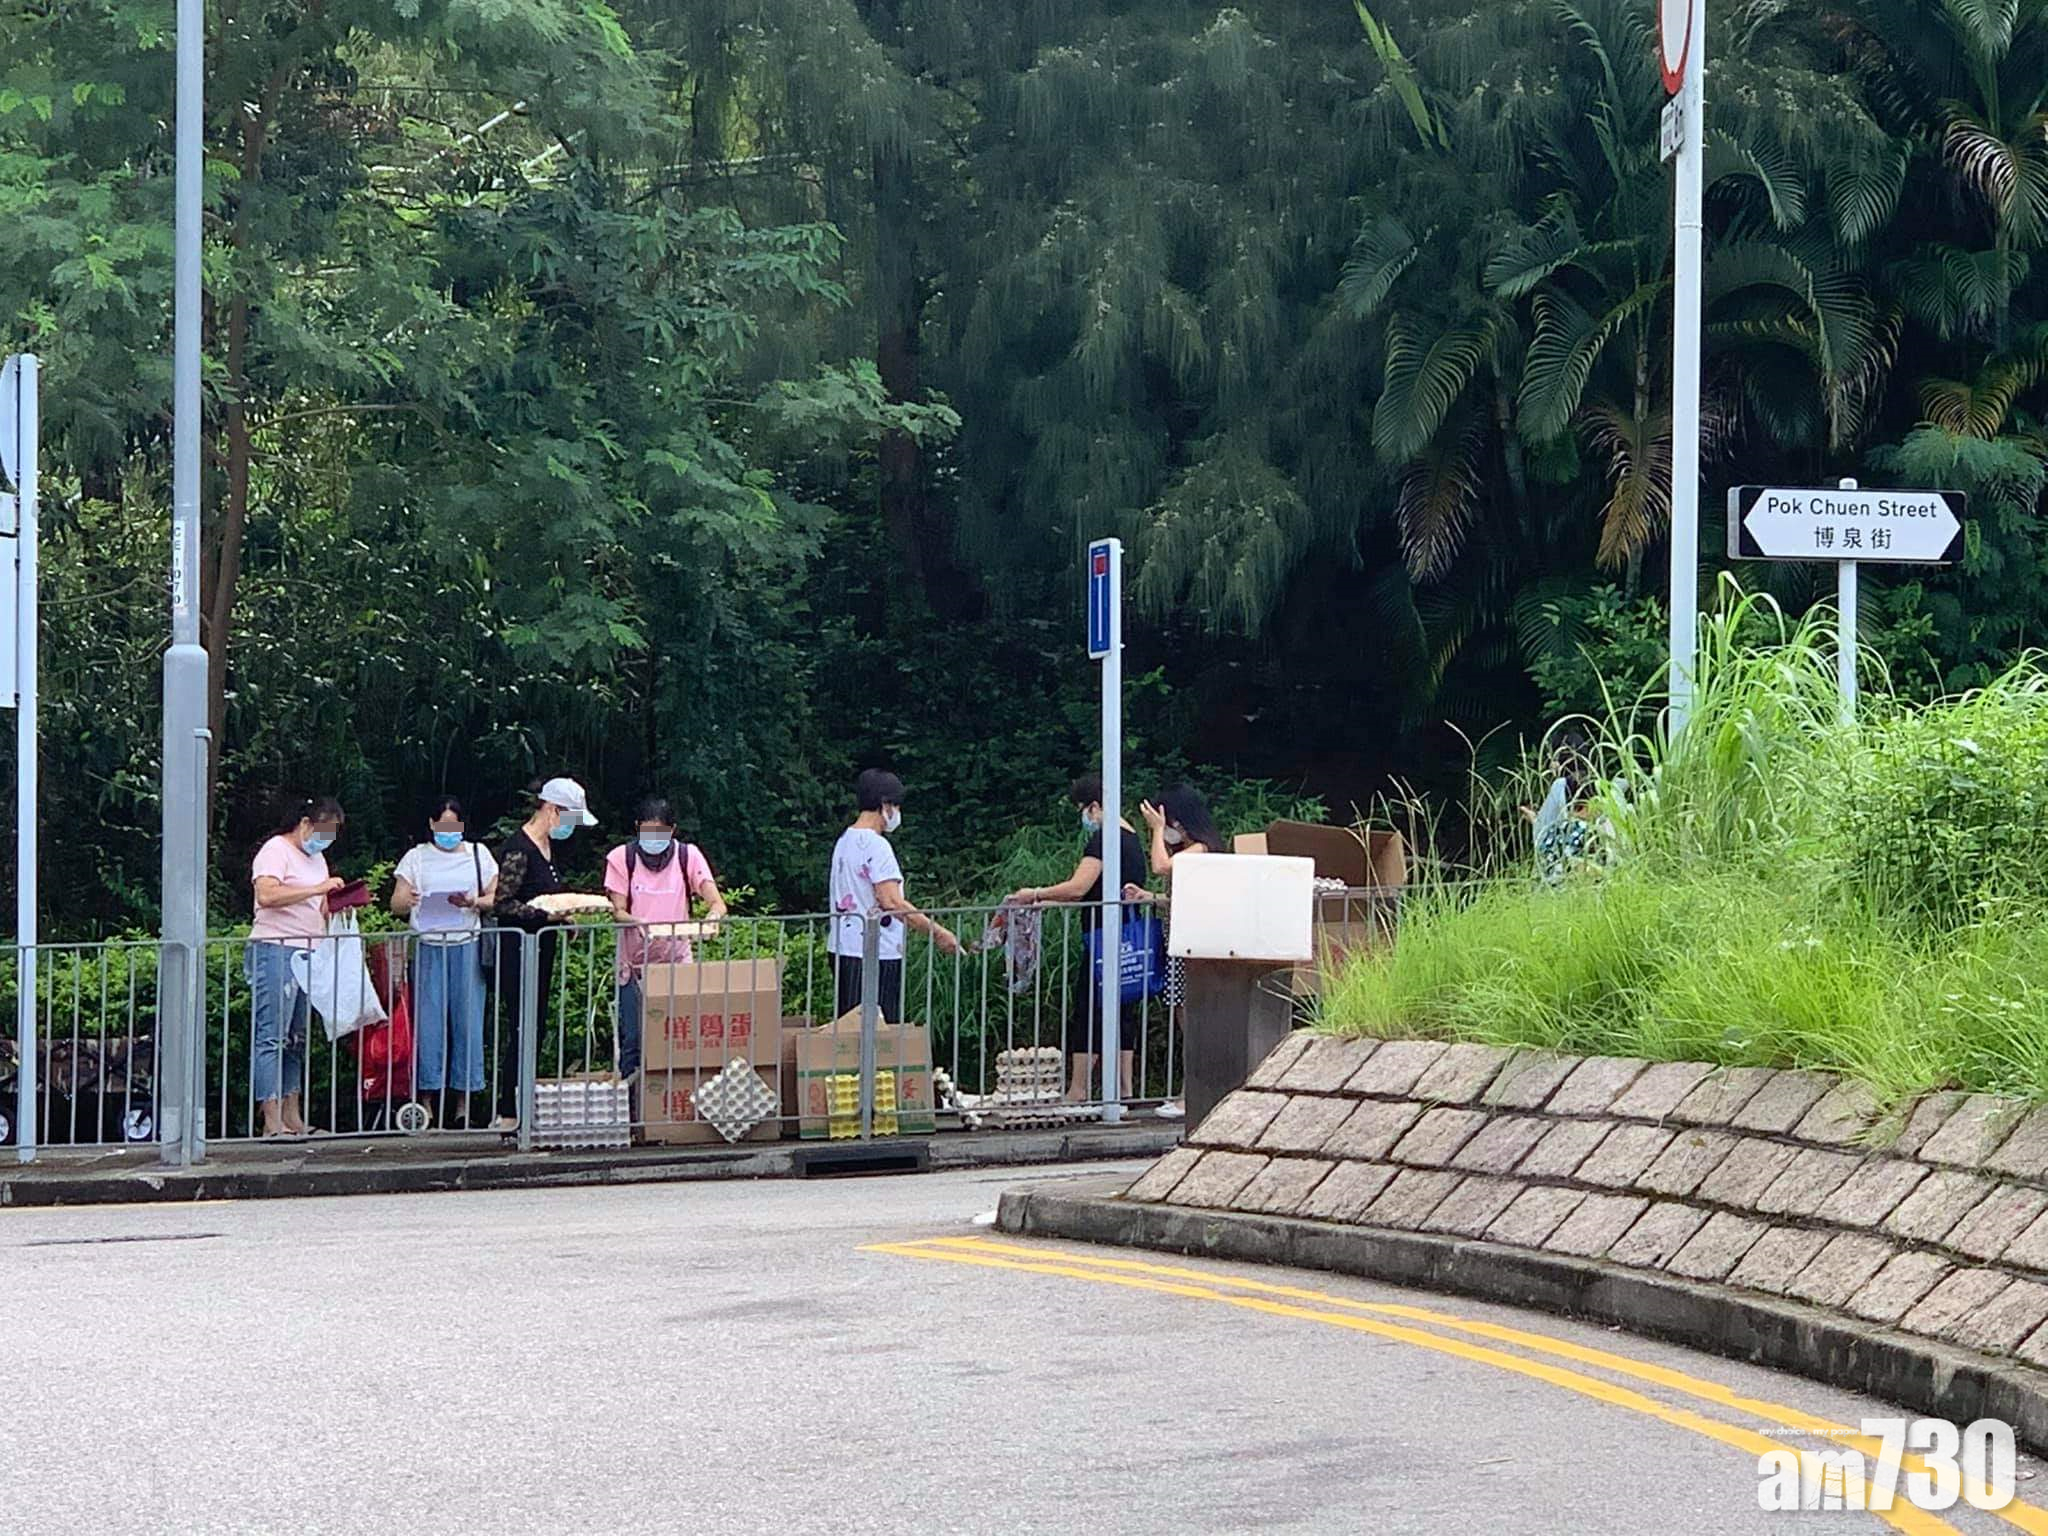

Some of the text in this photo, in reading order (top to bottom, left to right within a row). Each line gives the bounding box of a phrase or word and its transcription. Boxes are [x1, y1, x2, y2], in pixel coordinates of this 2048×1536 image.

[1768, 497, 1937, 518] Pok Chuen Street
[1813, 525, 1892, 549] 博泉街
